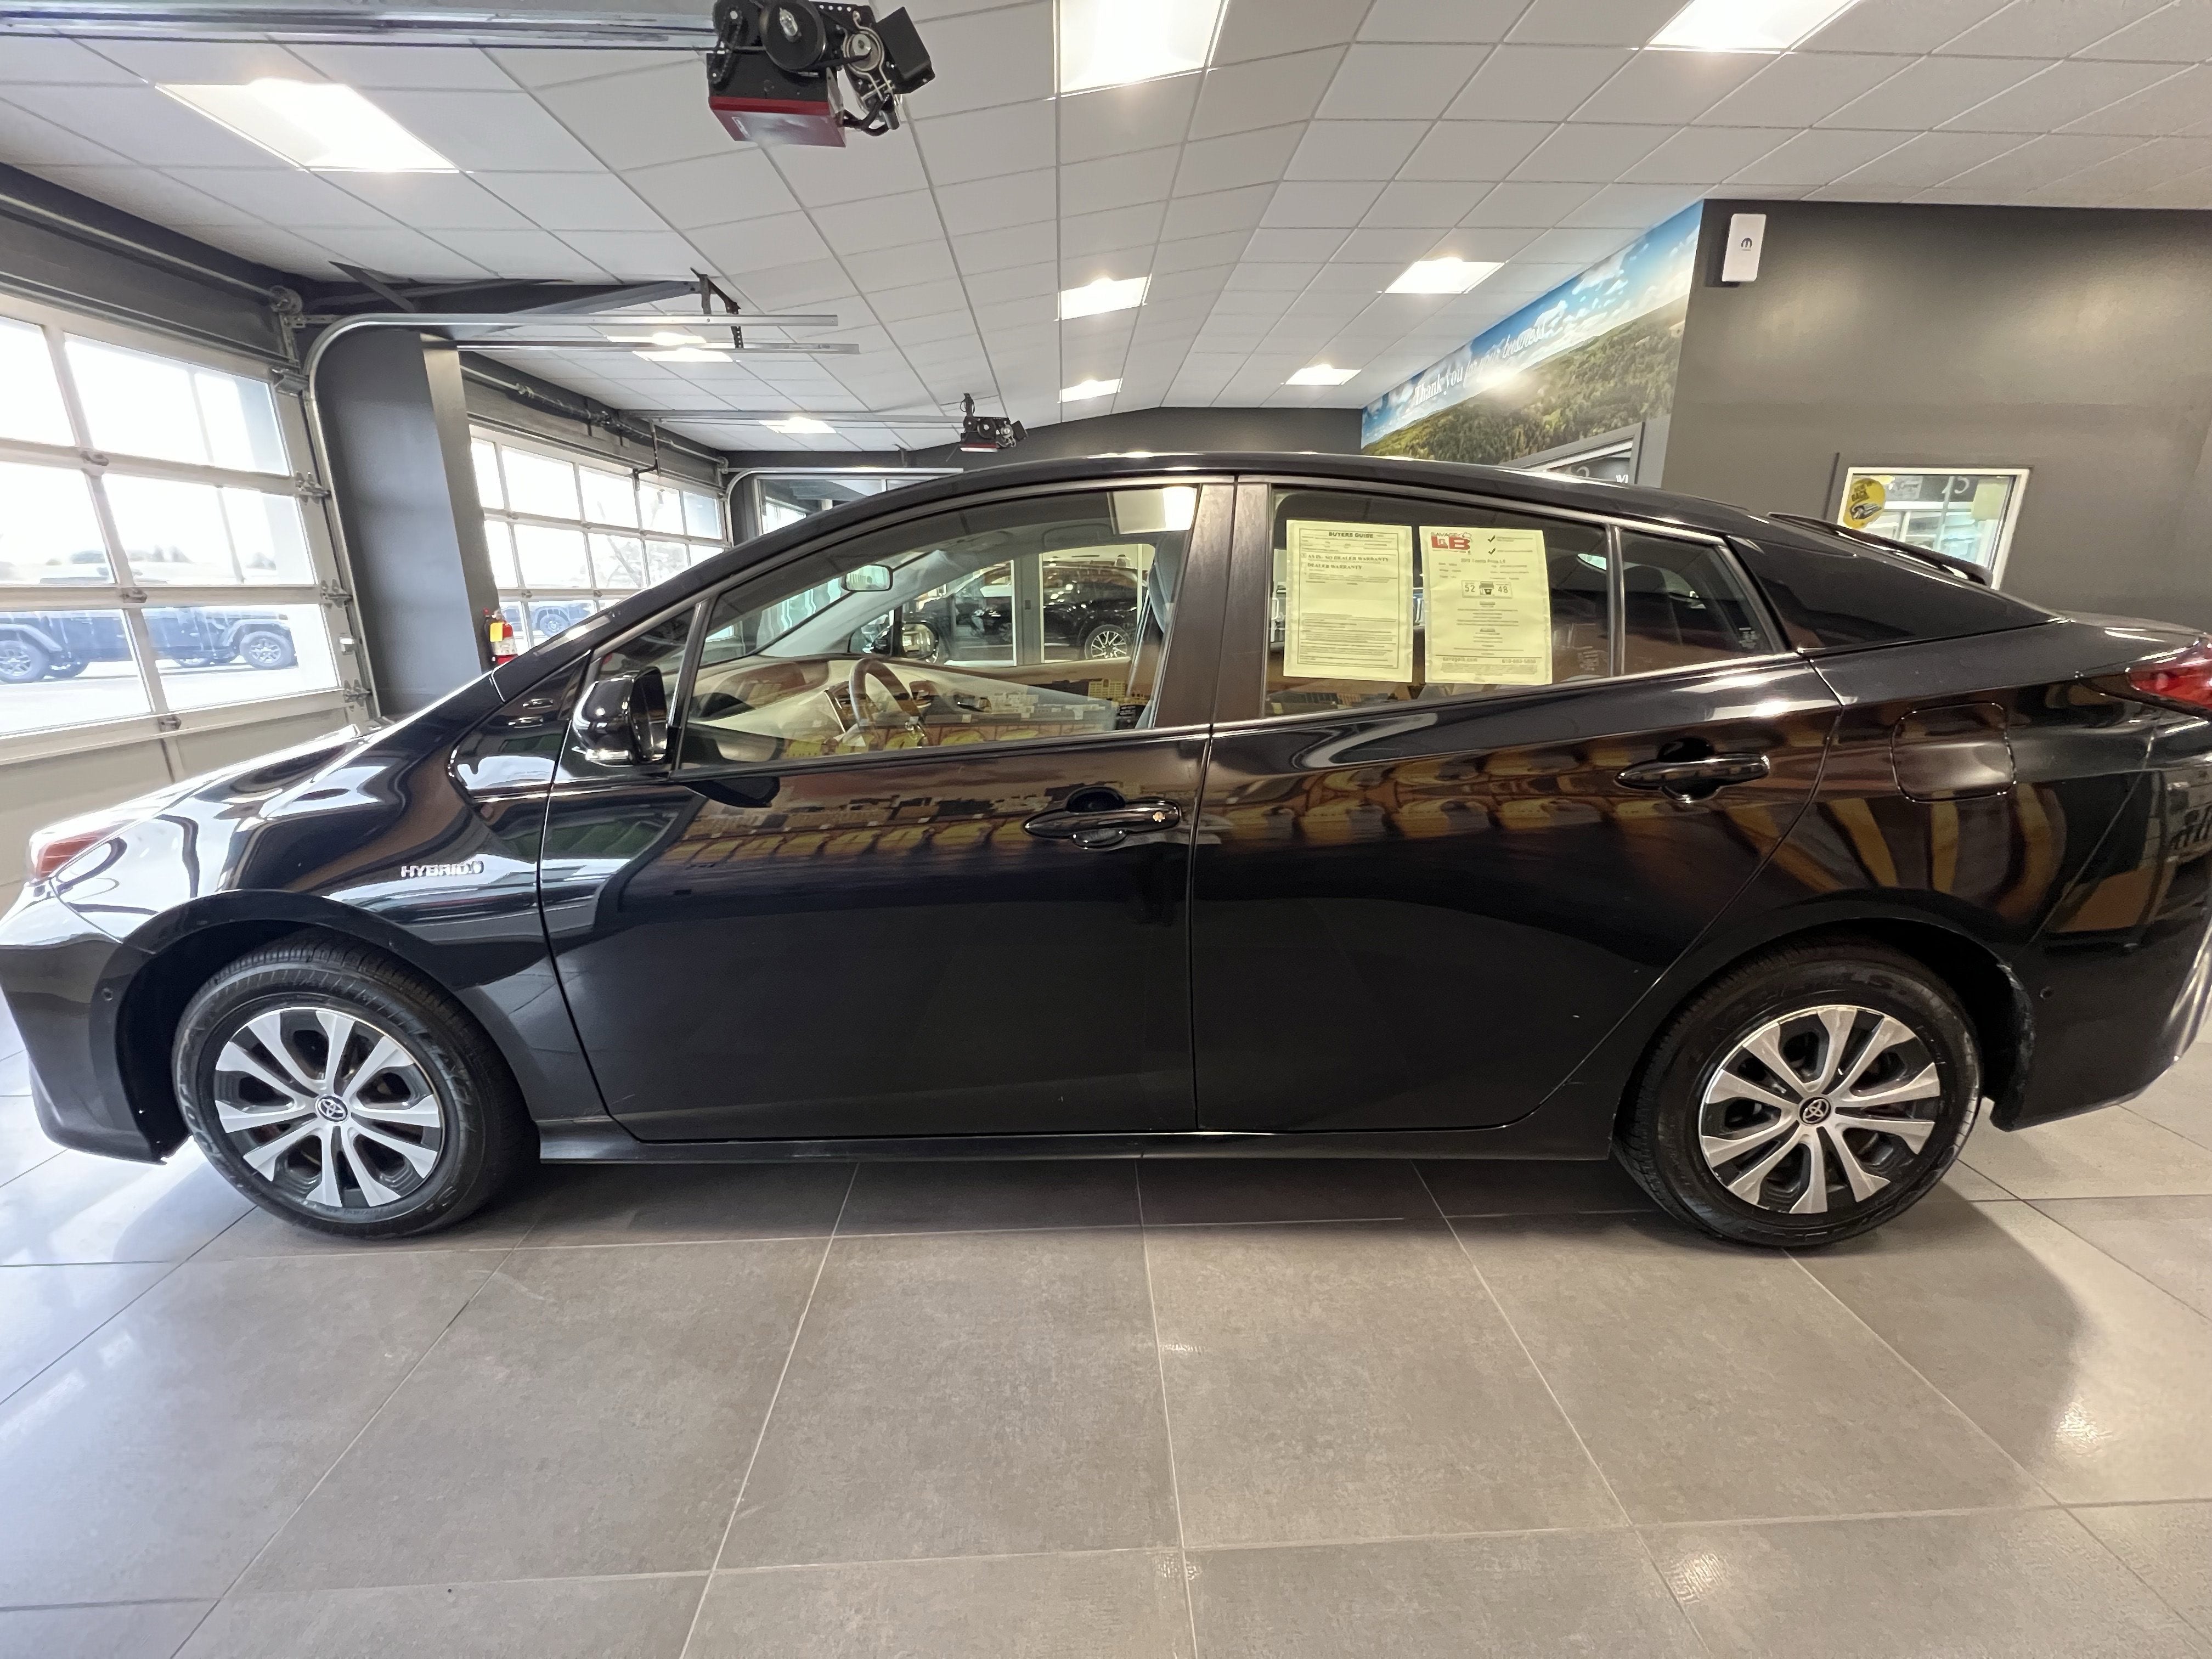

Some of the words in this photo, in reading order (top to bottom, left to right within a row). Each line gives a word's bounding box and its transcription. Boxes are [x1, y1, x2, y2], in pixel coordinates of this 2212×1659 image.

[1414, 374, 1442, 405] Thank
[1465, 584, 1475, 592] 52
[401, 863, 470, 877] HYBRID
